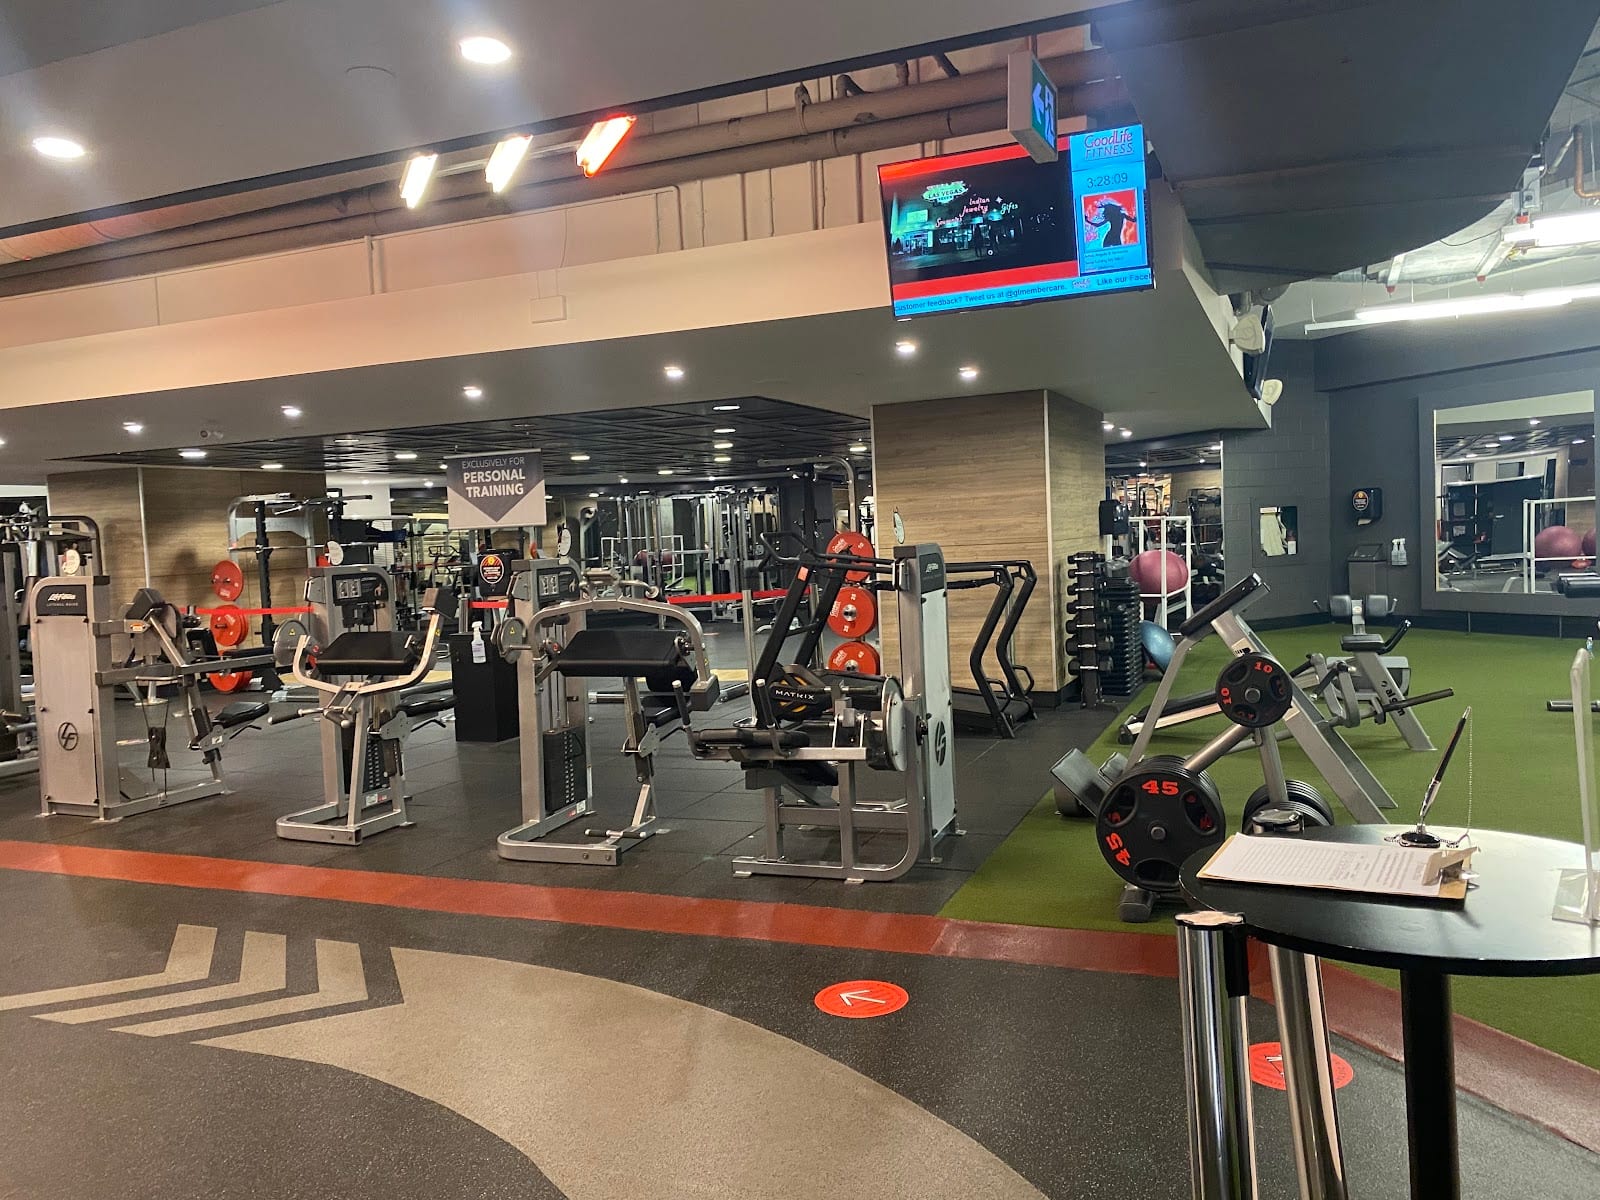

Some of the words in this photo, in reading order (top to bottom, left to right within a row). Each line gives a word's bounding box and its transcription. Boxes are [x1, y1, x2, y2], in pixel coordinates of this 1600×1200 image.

[1084, 129, 1133, 148] GoodLife
[1086, 142, 1134, 159] FITNESS
[1087, 172, 1128, 188] 3:28:09
[941, 188, 963, 197] VEGAS
[969, 197, 990, 206] Indian
[927, 296, 962, 307] feedback?
[965, 293, 985, 303] Tweet
[1097, 277, 1113, 286] Like
[461, 458, 507, 469] EXCLUSIVELY
[509, 456, 525, 466] FOR
[463, 468, 526, 484] PERSONAL
[466, 483, 524, 498] TRAINING
[1254, 661, 1273, 673] 10
[775, 689, 815, 700] MATRIX
[1220, 687, 1232, 705] 10
[1141, 779, 1180, 795] 45
[1105, 832, 1132, 867] 45
